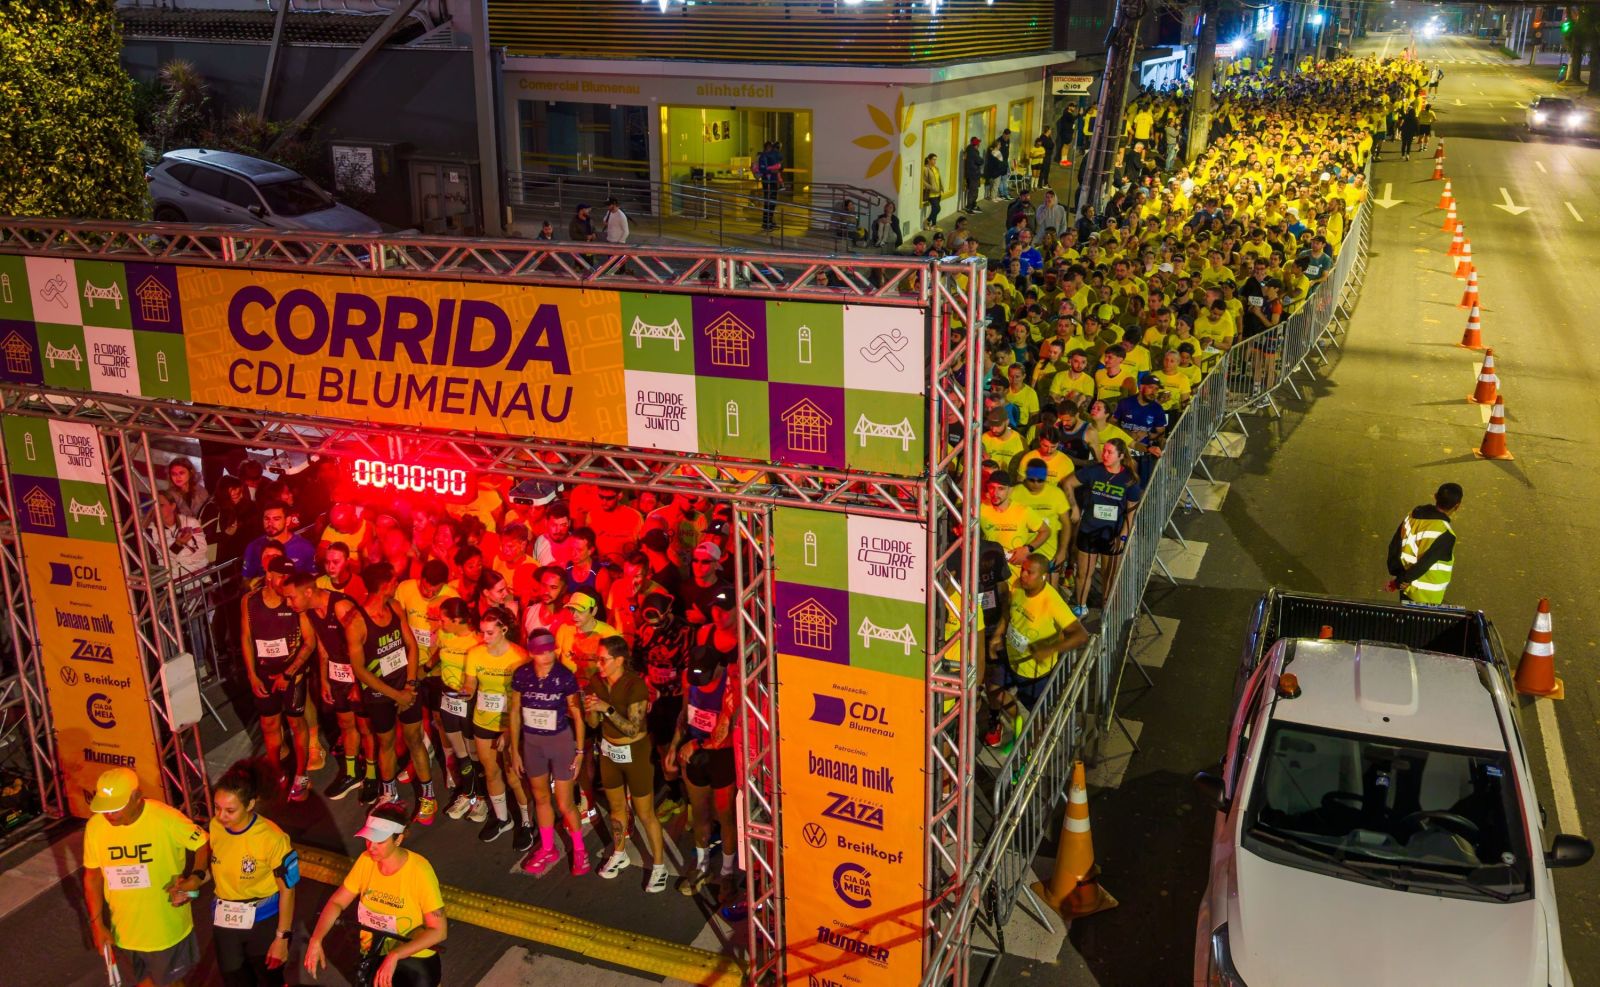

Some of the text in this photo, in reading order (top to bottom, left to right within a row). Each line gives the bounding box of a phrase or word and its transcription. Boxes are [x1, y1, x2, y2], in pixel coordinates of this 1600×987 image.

[519, 79, 640, 94] Comercial Blumenau
[228, 285, 571, 375] CORRIDA
[93, 342, 127, 356] A CIDADE
[93, 353, 131, 368] CORRE
[102, 365, 127, 378] JUNTO
[228, 358, 306, 400] CDL
[317, 366, 574, 424] BLUMENAU
[637, 390, 685, 406] A CIDADE
[635, 402, 688, 421] CORRE
[645, 417, 680, 432] JUNTO
[59, 434, 92, 448] A CIDADE
[68, 456, 92, 467] JUNTO
[354, 459, 467, 496] 00:00:00
[860, 535, 913, 555] A CIDADE
[857, 548, 917, 569] CORRE
[74, 565, 102, 582] CDL
[867, 564, 907, 581] JUNTO
[76, 582, 107, 592] Blumenau
[55, 607, 115, 635] banana milk
[71, 638, 114, 664] ZATA
[84, 673, 131, 690] Breitkopf
[485, 701, 500, 709] 273
[849, 701, 889, 725] CDL
[94, 710, 115, 719] MEIA
[849, 721, 895, 738] Blumenau
[607, 751, 626, 760] 1030
[808, 750, 895, 794] banana milk
[821, 791, 884, 830] ZATA
[107, 843, 153, 864] DUE
[837, 835, 904, 864] Breitkopf
[120, 876, 140, 885] 802
[843, 874, 871, 888] CIA DA
[844, 881, 872, 899] MEIA
[224, 913, 244, 924] 841
